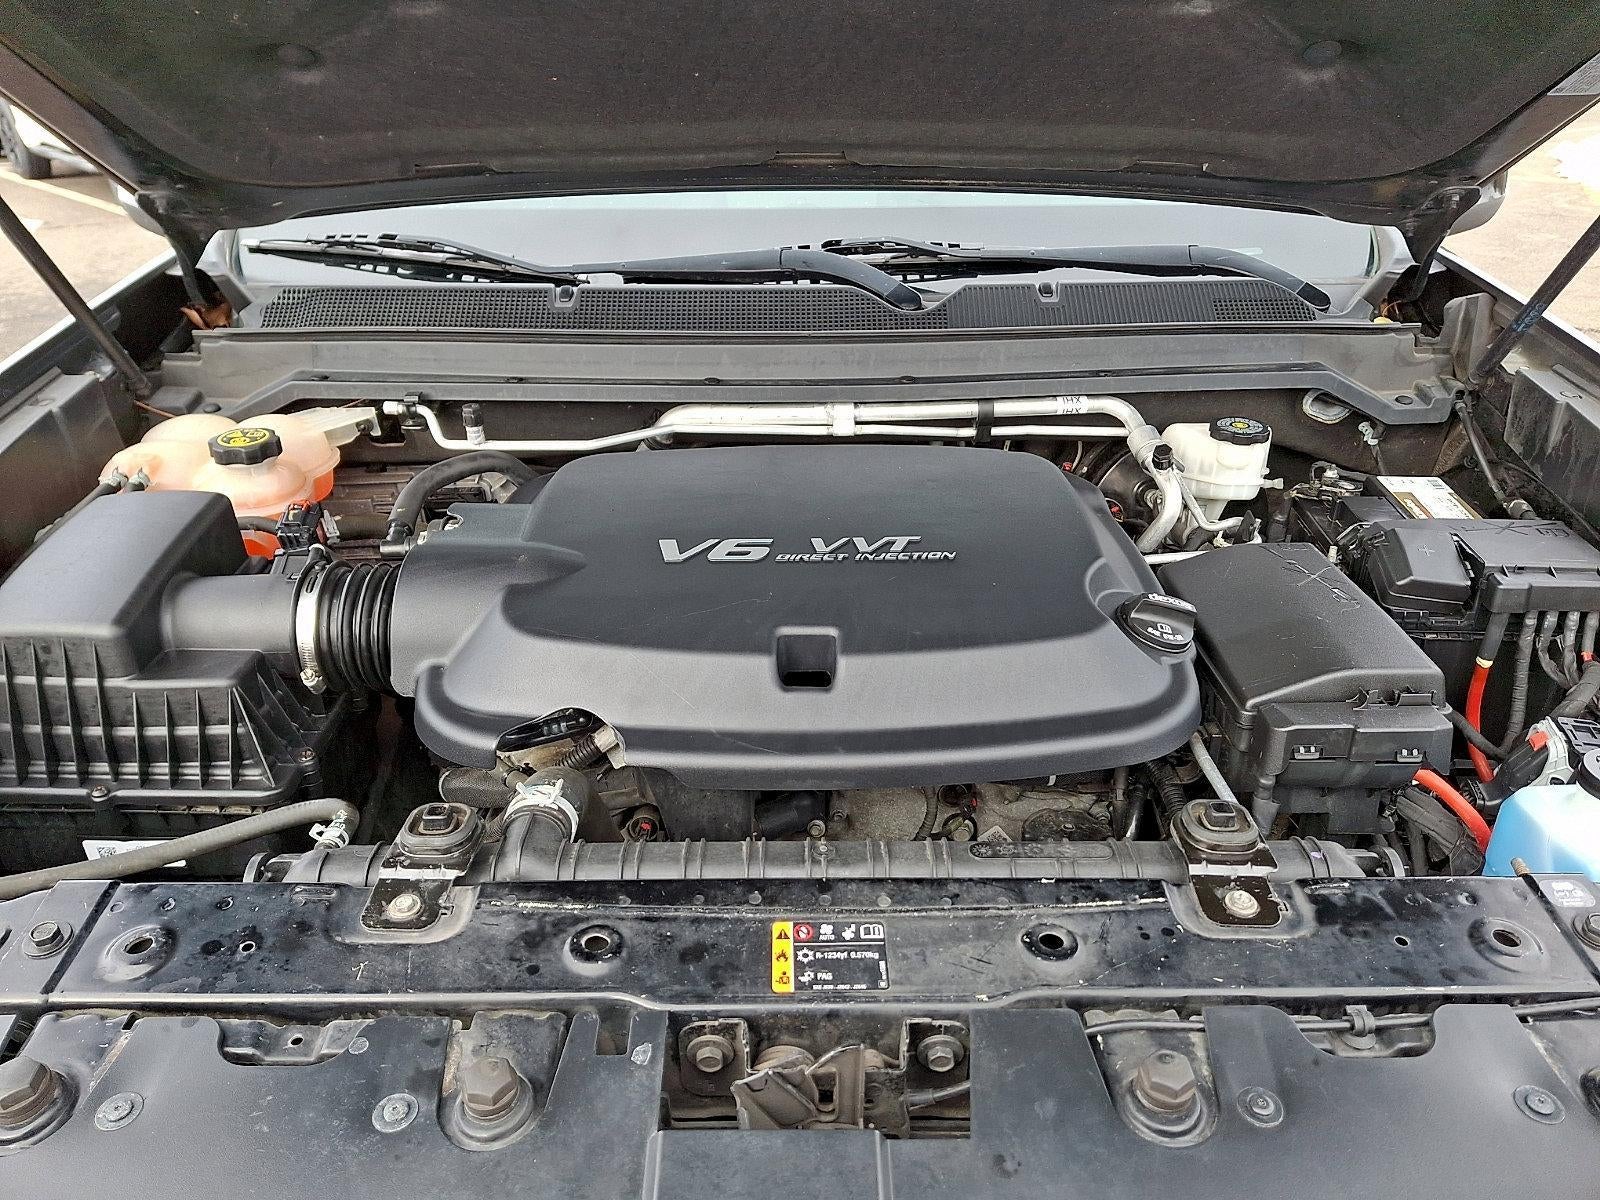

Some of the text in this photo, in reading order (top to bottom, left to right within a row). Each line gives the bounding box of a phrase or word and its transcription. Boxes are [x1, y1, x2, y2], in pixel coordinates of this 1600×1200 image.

[658, 538, 774, 562] V6
[810, 536, 922, 553] VVT
[774, 551, 957, 562] DIRECT INJECTION
[817, 973, 833, 981] PAG
